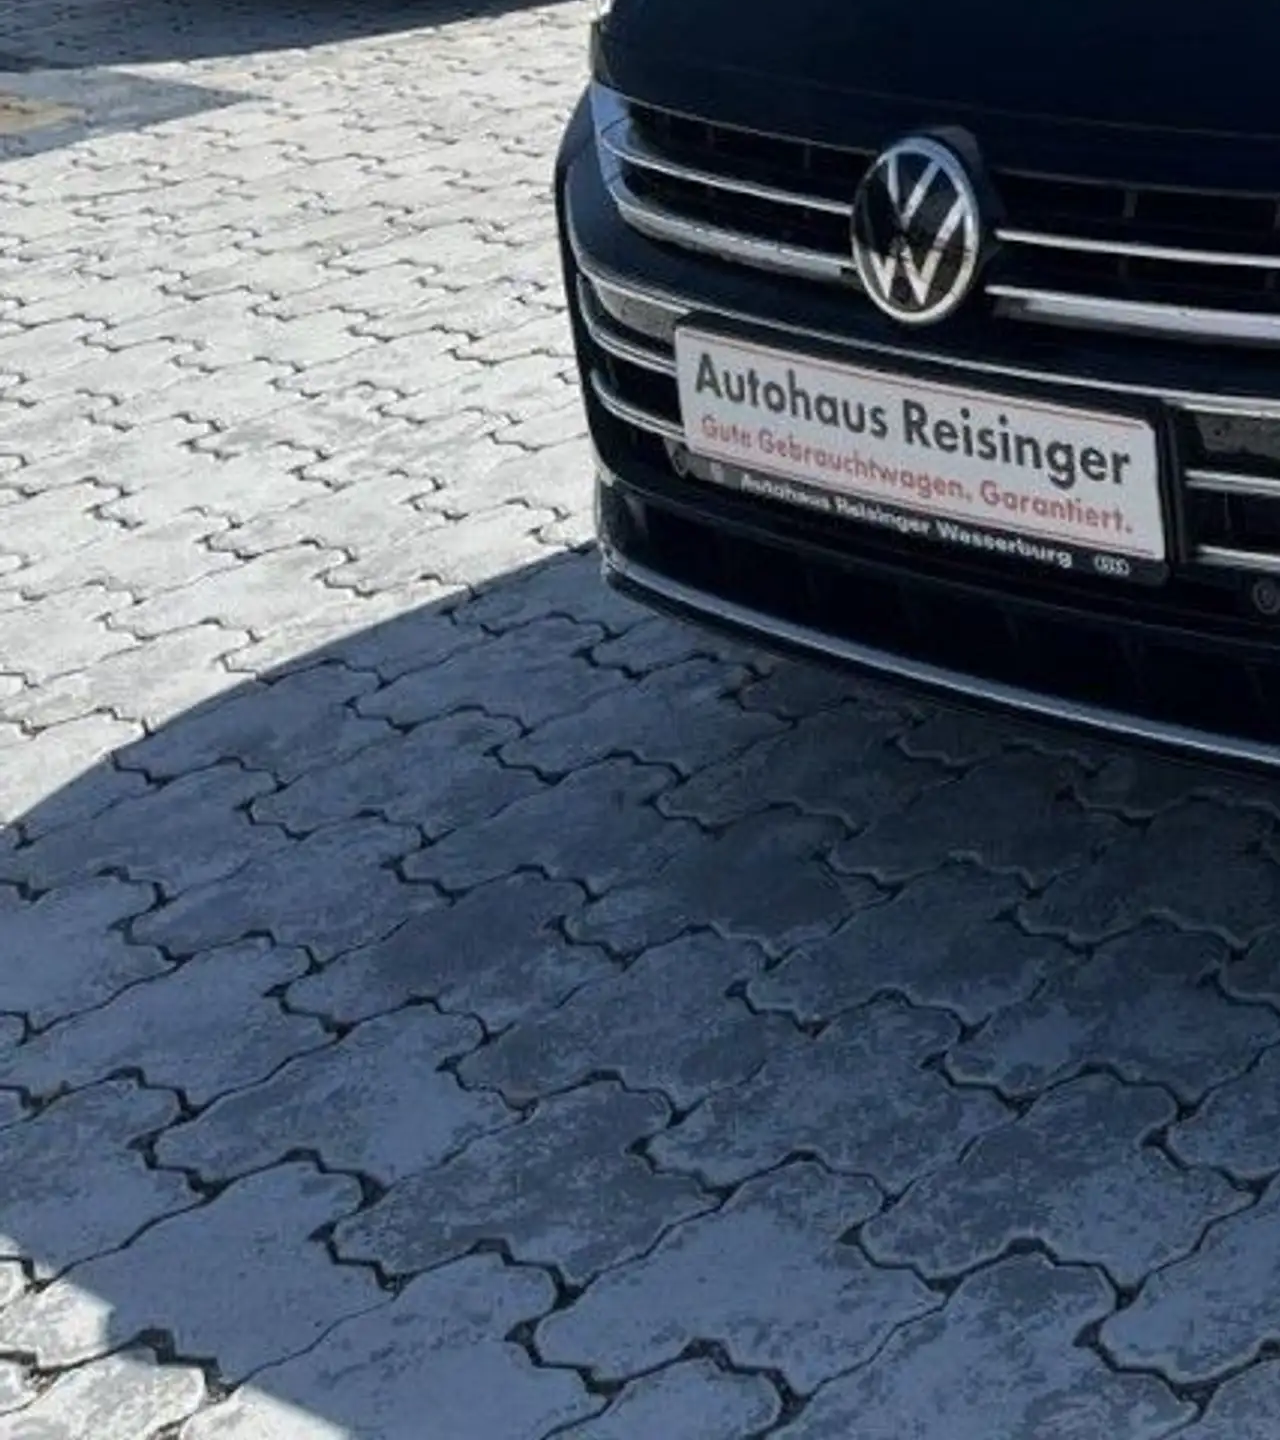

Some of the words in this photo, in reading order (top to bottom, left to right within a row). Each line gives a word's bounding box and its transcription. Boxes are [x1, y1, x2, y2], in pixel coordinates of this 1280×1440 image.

[696, 352, 888, 439] Autohaus
[902, 398, 1131, 490] Reisinger
[701, 414, 752, 448] Gute
[758, 427, 973, 503] Gebrauchtwagen.
[979, 479, 1133, 534] Garantiert.
[740, 472, 831, 510] Autohaus
[833, 495, 931, 536] Reisinger
[935, 518, 1073, 569] Wasserburg
